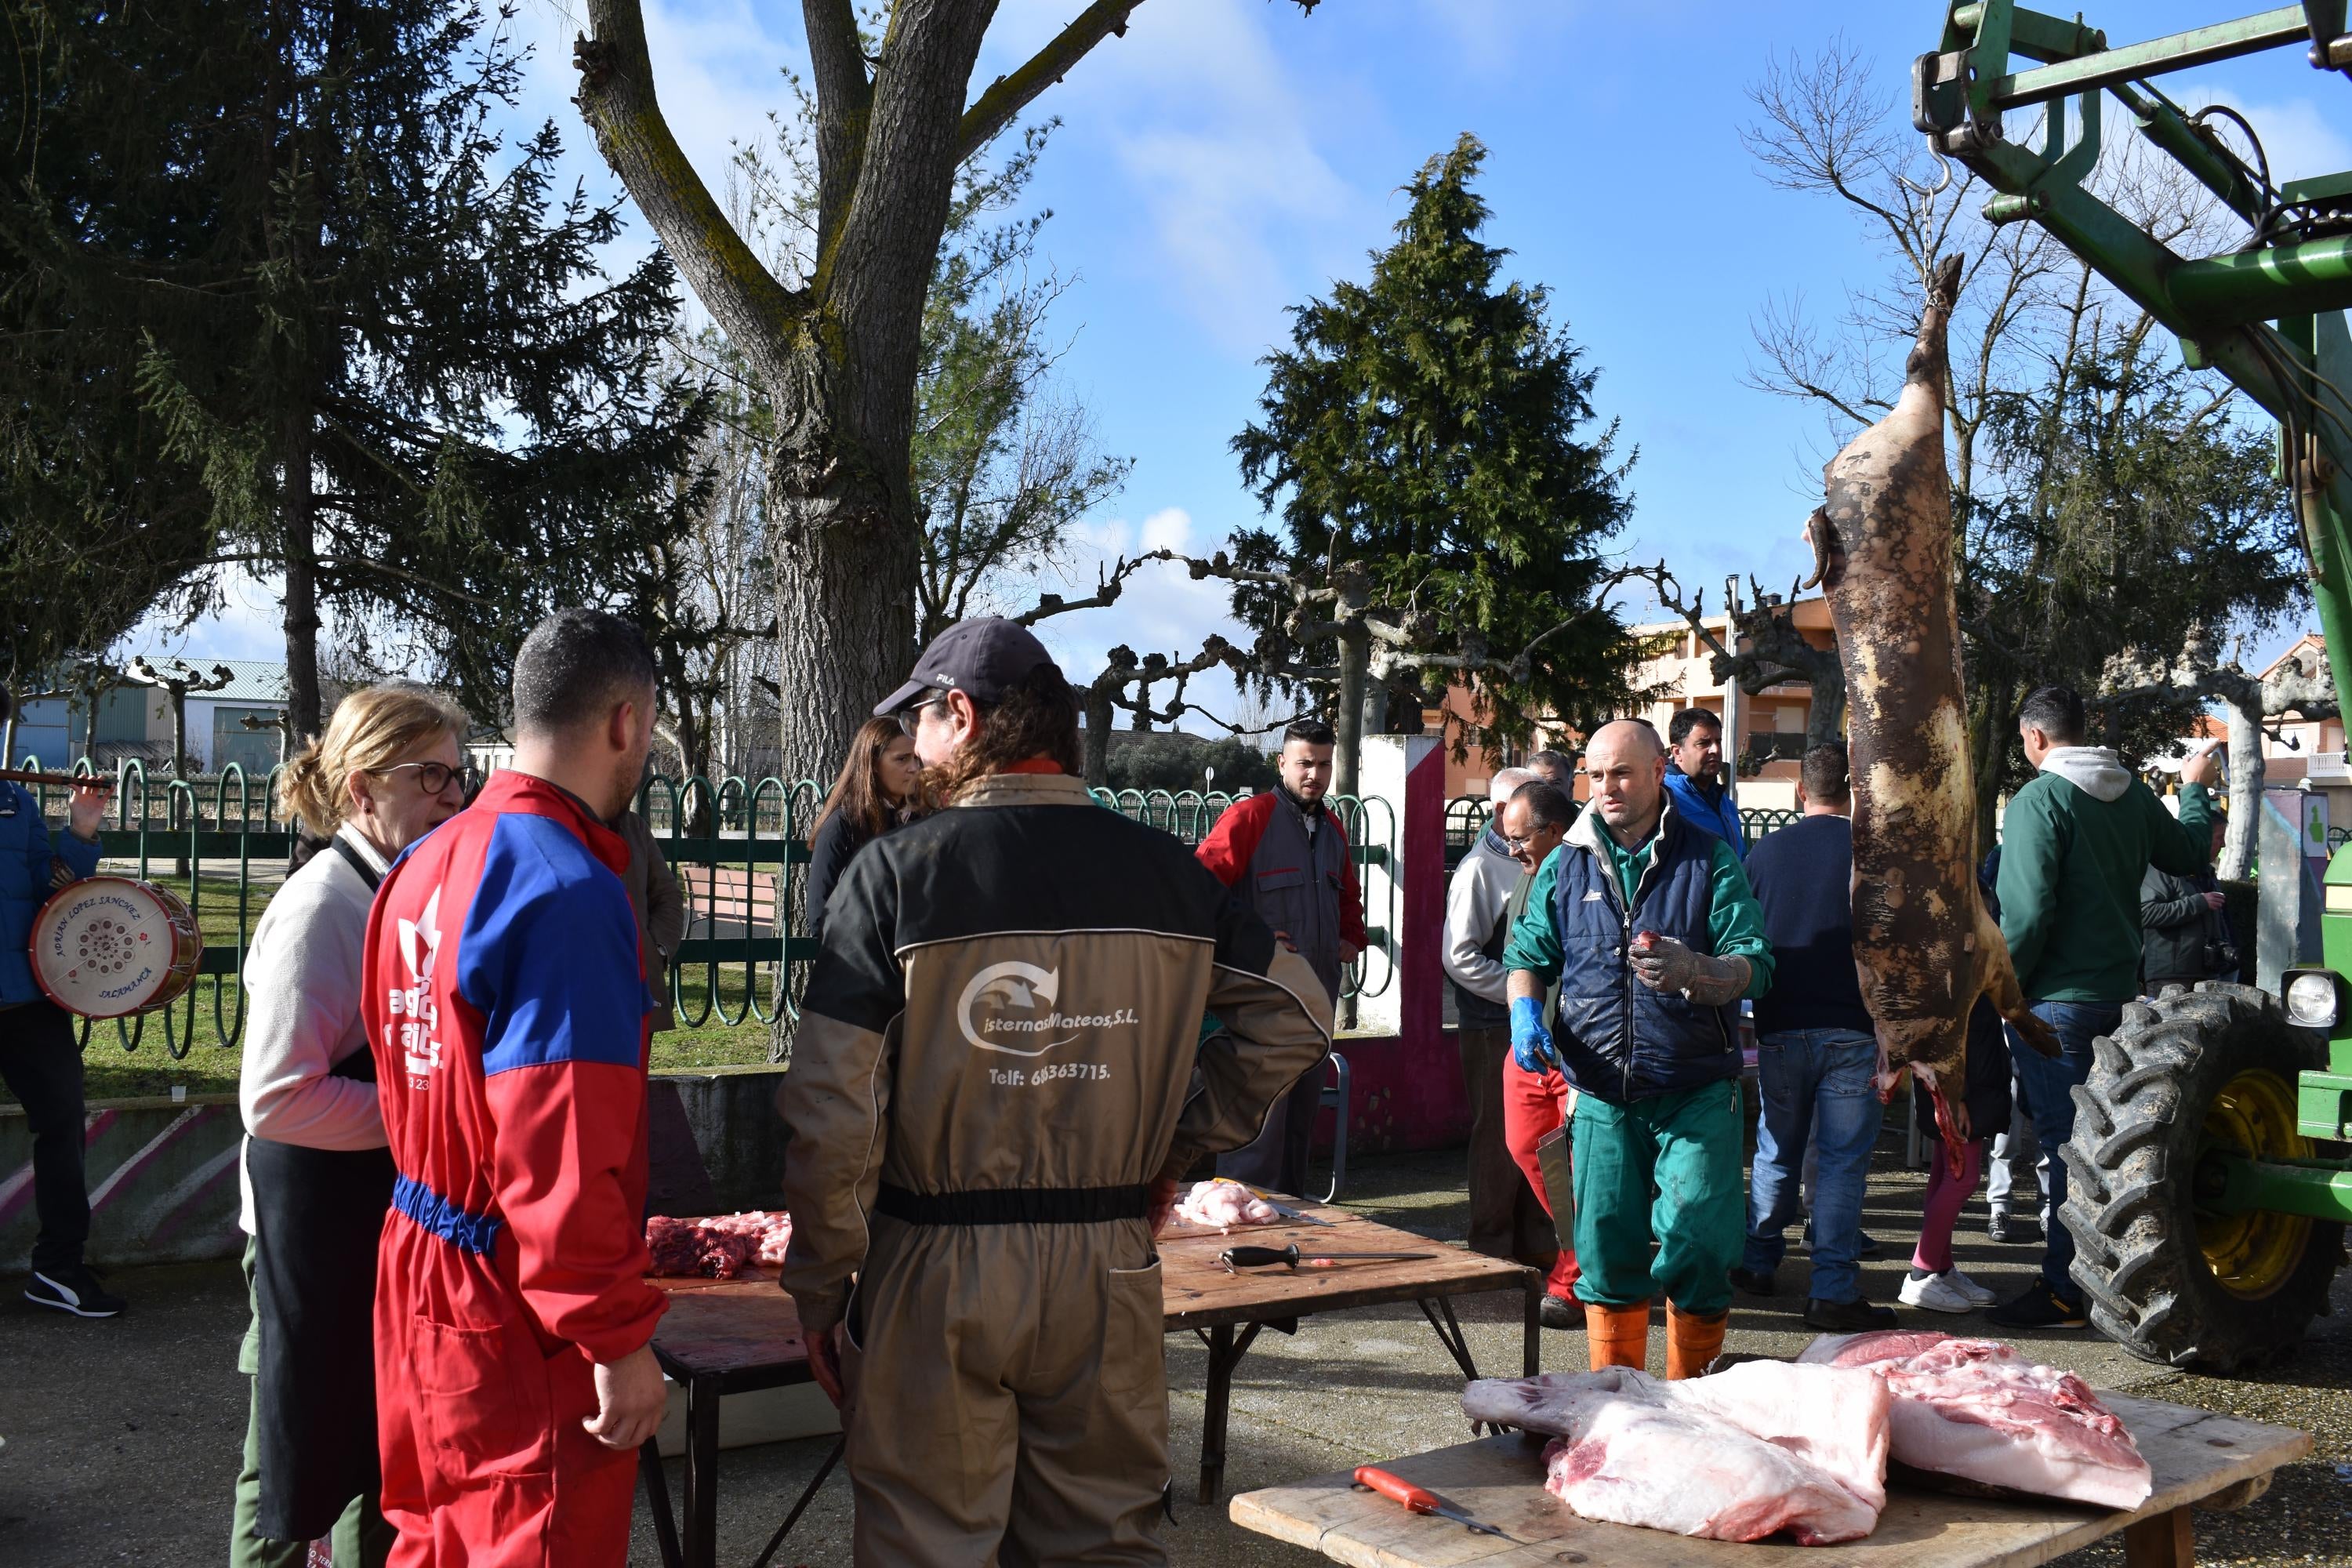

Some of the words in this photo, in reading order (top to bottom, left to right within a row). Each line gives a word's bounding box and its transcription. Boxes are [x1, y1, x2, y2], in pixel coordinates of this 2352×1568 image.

[936, 673, 955, 686] FILA
[68, 898, 96, 919] LOPEZ
[99, 896, 141, 920] SANCHEZ
[99, 967, 151, 998] SALAMANCA
[989, 1069, 1025, 1086] Telf:
